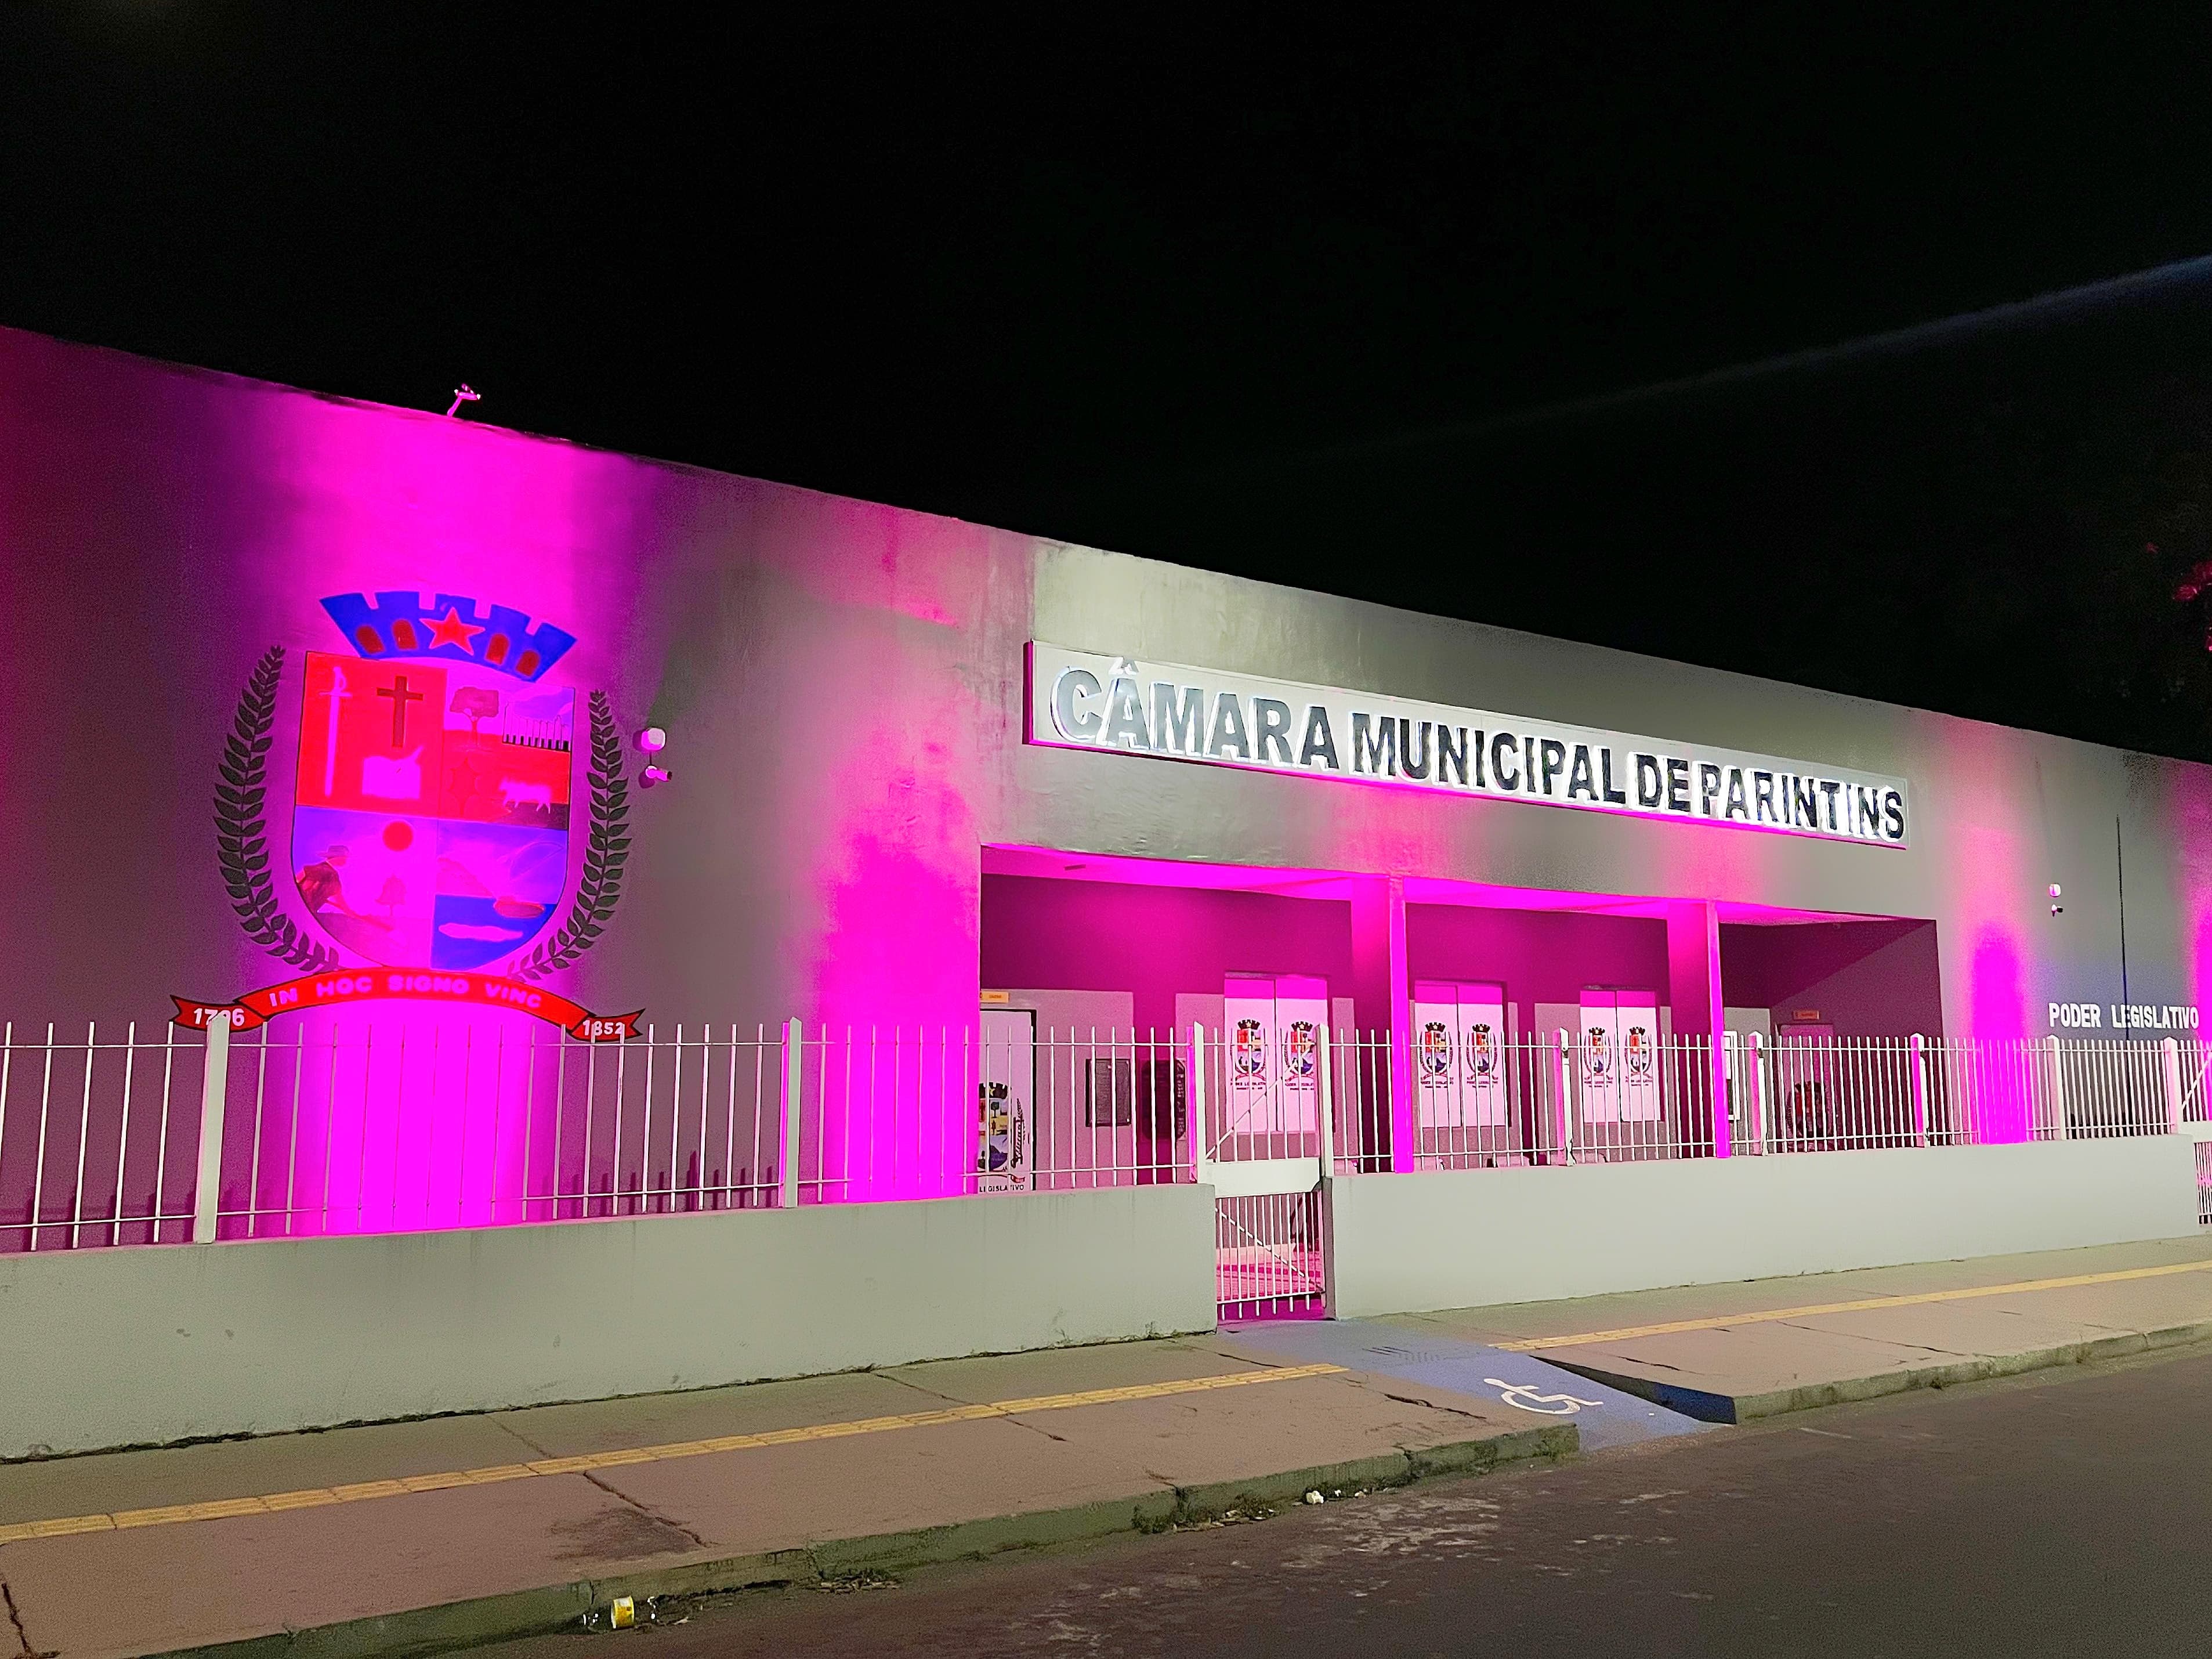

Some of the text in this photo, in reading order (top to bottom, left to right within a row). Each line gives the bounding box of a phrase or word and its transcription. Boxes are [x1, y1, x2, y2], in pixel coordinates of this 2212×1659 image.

[1051, 657, 1904, 843] CÂMARA MUNICIPAL DE PARINTINS
[269, 988, 298, 1007] IN
[316, 977, 372, 997] HOC
[388, 975, 470, 994] SIGNO
[582, 1020, 624, 1036] 1852
[2048, 1002, 2199, 1029] PODER LEGISLATIVO
